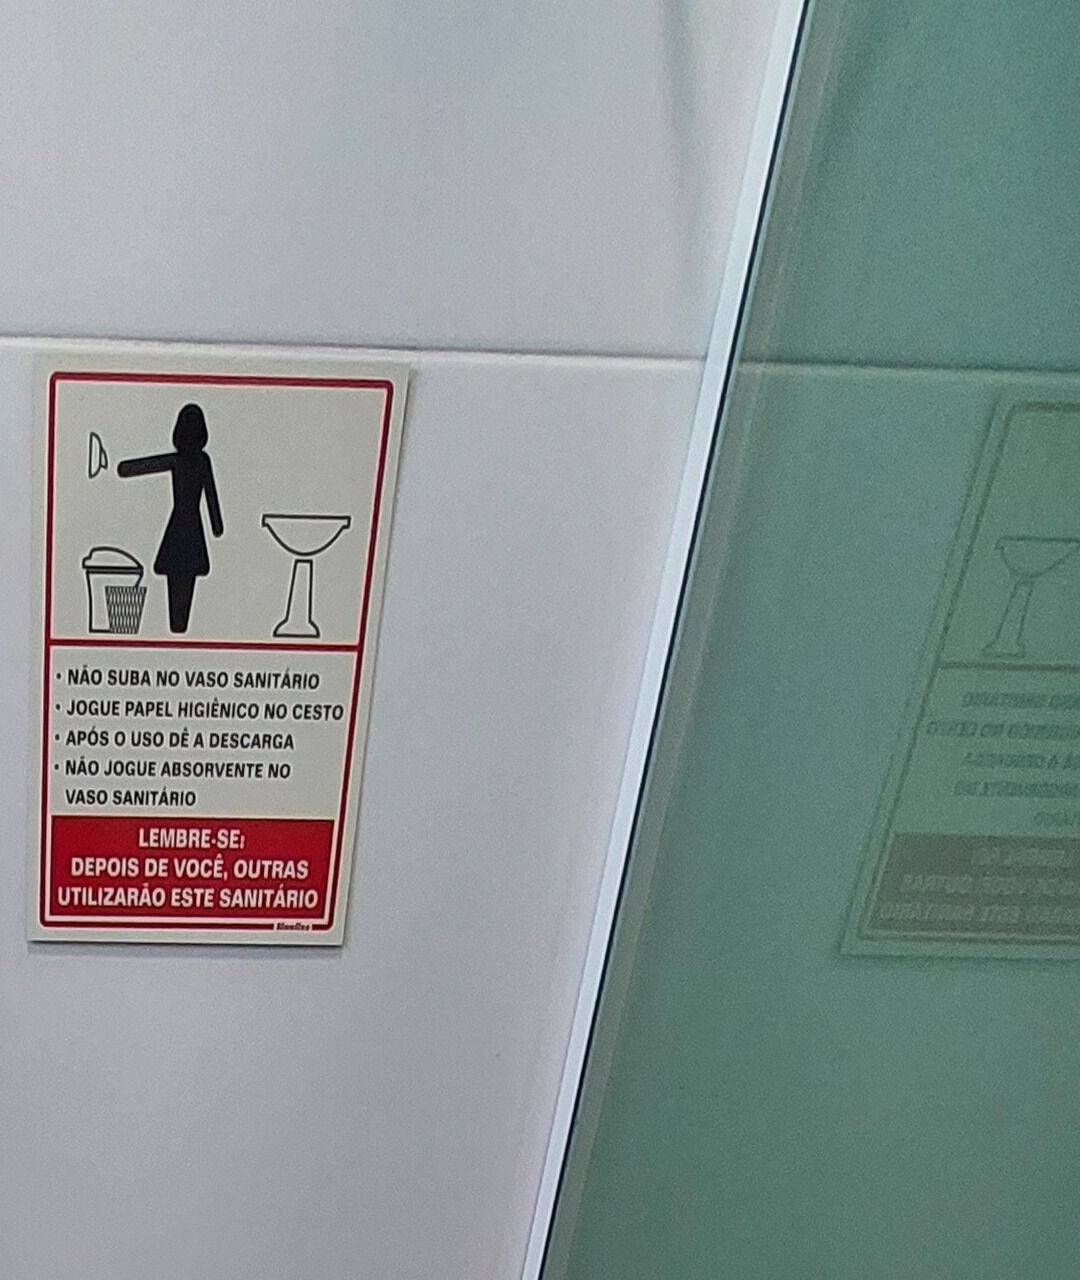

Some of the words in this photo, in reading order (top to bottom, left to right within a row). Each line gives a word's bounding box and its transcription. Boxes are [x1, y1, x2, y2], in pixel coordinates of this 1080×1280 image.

[68, 664, 102, 686] NÃO
[107, 669, 151, 687] SUBA
[156, 670, 180, 687] NO
[185, 671, 228, 688] VASO
[233, 667, 320, 690] SANITÁRIO
[66, 700, 120, 716] JOGUE
[125, 701, 173, 718] PAPEL
[178, 697, 259, 719] HIGIÊNICO
[264, 703, 288, 720] NO
[292, 704, 344, 721] CESTO
[65, 725, 109, 746] APÓS
[114, 731, 126, 747] O
[131, 731, 165, 748] USO
[169, 727, 189, 748] DÊ
[193, 732, 205, 749] A
[209, 732, 295, 750] DESCARGA
[65, 755, 100, 776] NÃO
[104, 760, 157, 777] JOGUE
[161, 761, 263, 778] ABSORVENTE
[268, 763, 292, 779] NO
[65, 789, 108, 804] VASO
[112, 785, 197, 806] SANITÁRIO
[138, 827, 245, 849] LEMBRE-SE:
[71, 857, 139, 877] DEPOIS
[144, 858, 168, 877] DE
[173, 853, 228, 880] VOCÊ,
[233, 859, 309, 879] OUTRAS
[58, 882, 166, 907] UTILIZARÃO
[170, 888, 215, 908] ESTE
[219, 883, 318, 909] SANITÁRIO
